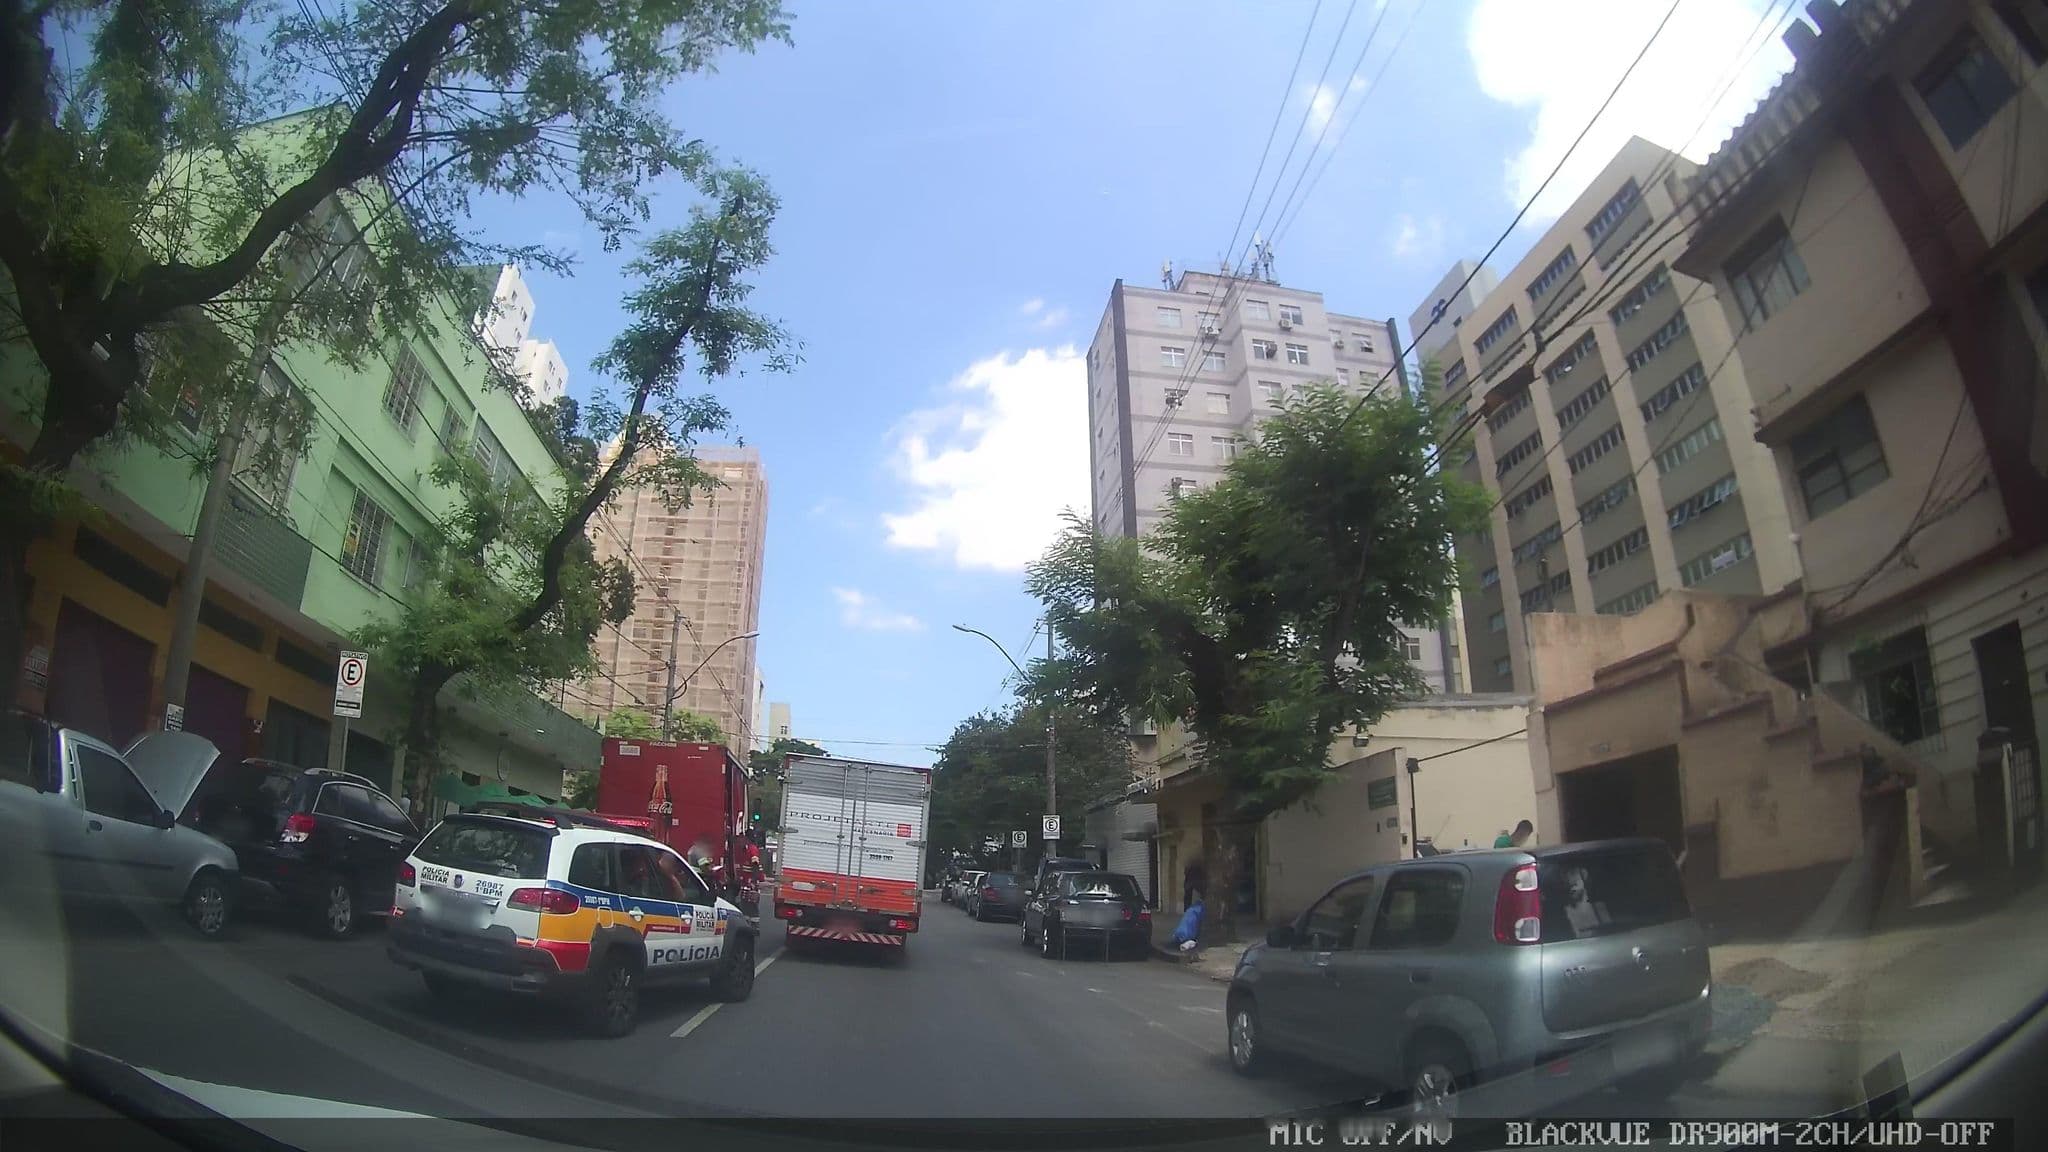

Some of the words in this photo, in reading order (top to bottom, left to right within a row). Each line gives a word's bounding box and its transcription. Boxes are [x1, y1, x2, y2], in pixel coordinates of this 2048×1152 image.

[347, 663, 357, 681] E
[421, 873, 448, 884] MILITAR
[476, 880, 504, 891] 26987
[653, 945, 721, 964] POLÍCIA
